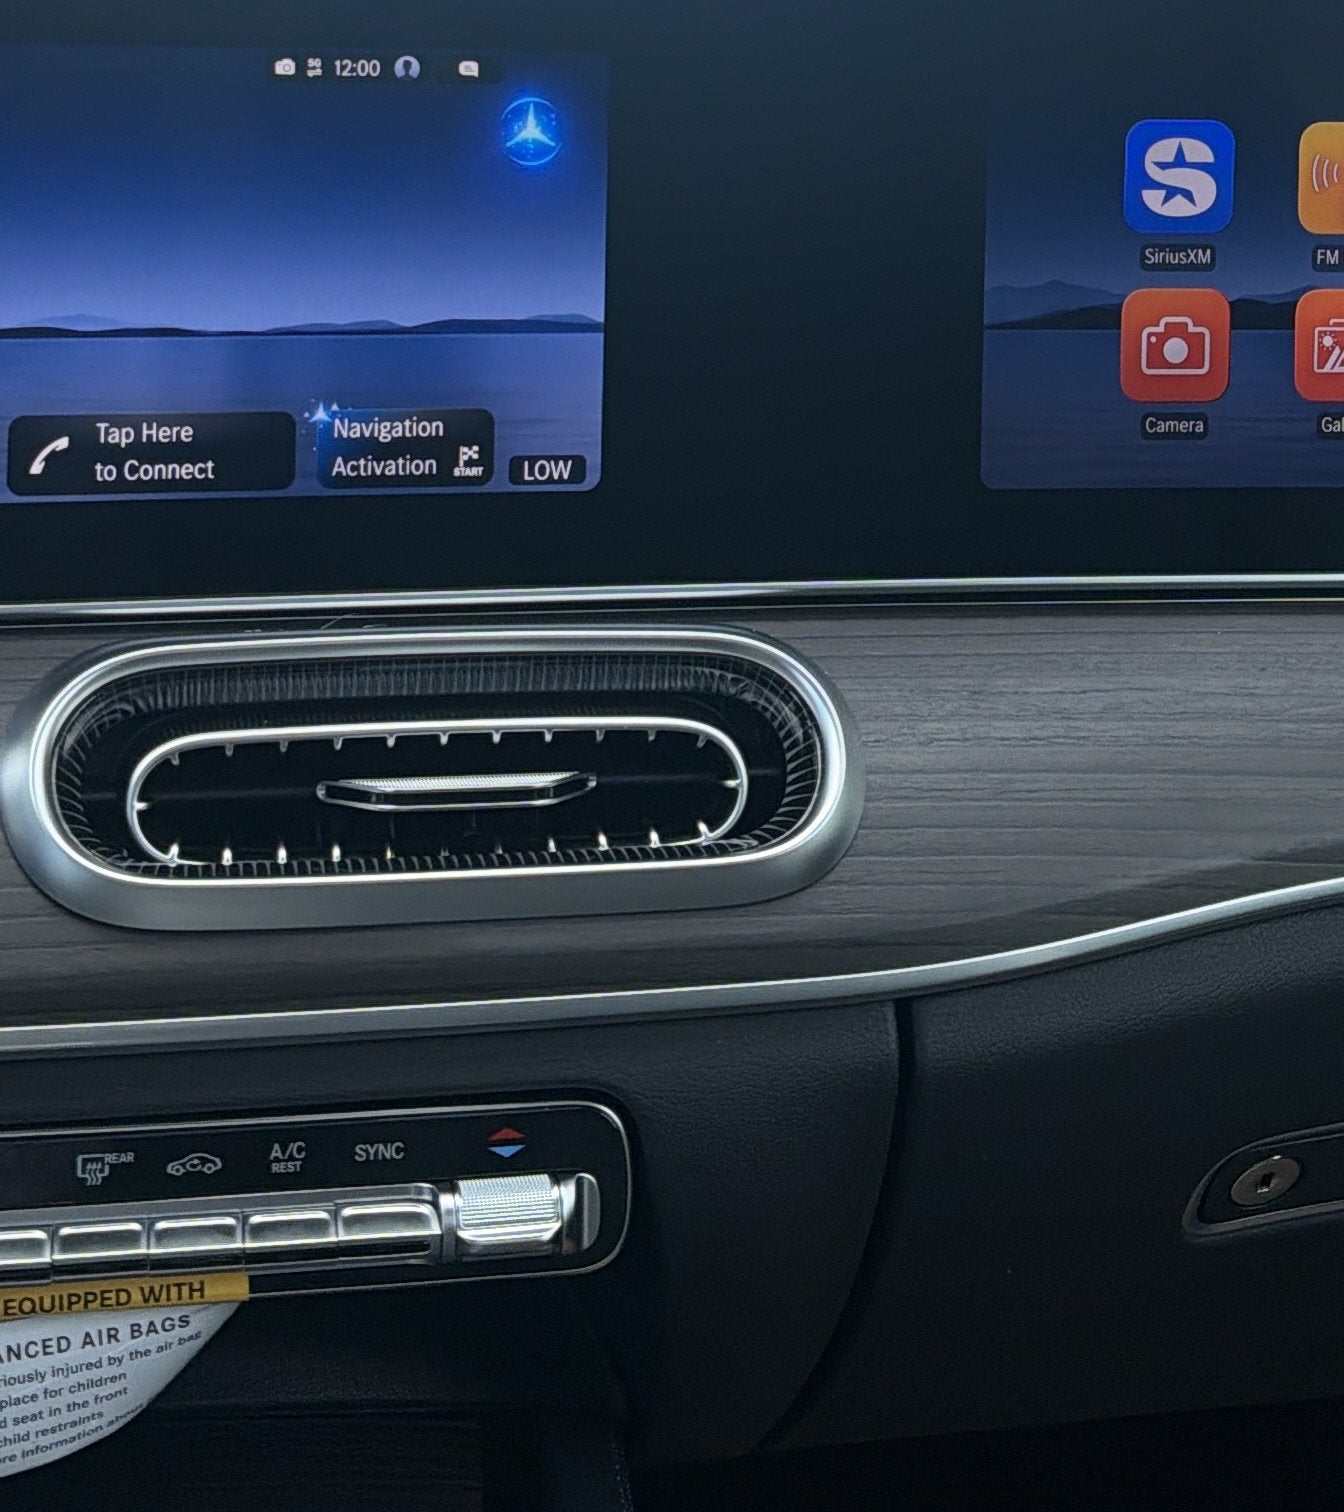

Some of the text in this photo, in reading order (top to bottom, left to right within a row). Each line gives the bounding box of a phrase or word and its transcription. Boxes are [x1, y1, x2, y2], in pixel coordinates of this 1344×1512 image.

[335, 59, 381, 77] 12:00
[1144, 247, 1212, 266] SiriusXM
[1316, 249, 1340, 266] FM
[96, 421, 194, 447] Tap Here
[333, 417, 444, 441] Navigation
[1145, 416, 1204, 434] Camera
[95, 457, 215, 482] to Connect
[332, 455, 438, 478] Activation
[453, 465, 484, 477] START
[522, 459, 573, 482] LOW
[104, 1152, 135, 1164] REAR
[269, 1140, 306, 1162] A/C
[354, 1141, 405, 1162] SYNC
[271, 1161, 302, 1174] REST
[3, 1287, 133, 1317] EQUIPPED
[139, 1280, 205, 1305] WITH
[81, 1326, 120, 1350] AIR
[129, 1314, 191, 1340] BAGS
[51, 1357, 103, 1379] injured
[107, 1354, 125, 1368] by
[128, 1348, 152, 1362] the
[155, 1341, 174, 1354] air
[0, 1391, 39, 1413] place
[43, 1385, 65, 1400] for
[68, 1371, 128, 1395] children
[12, 1409, 45, 1427] seat
[48, 1405, 62, 1419] in
[66, 1397, 90, 1414] the
[94, 1386, 129, 1406] front
[34, 1409, 105, 1440] restraints
[21, 1424, 104, 1460] information
